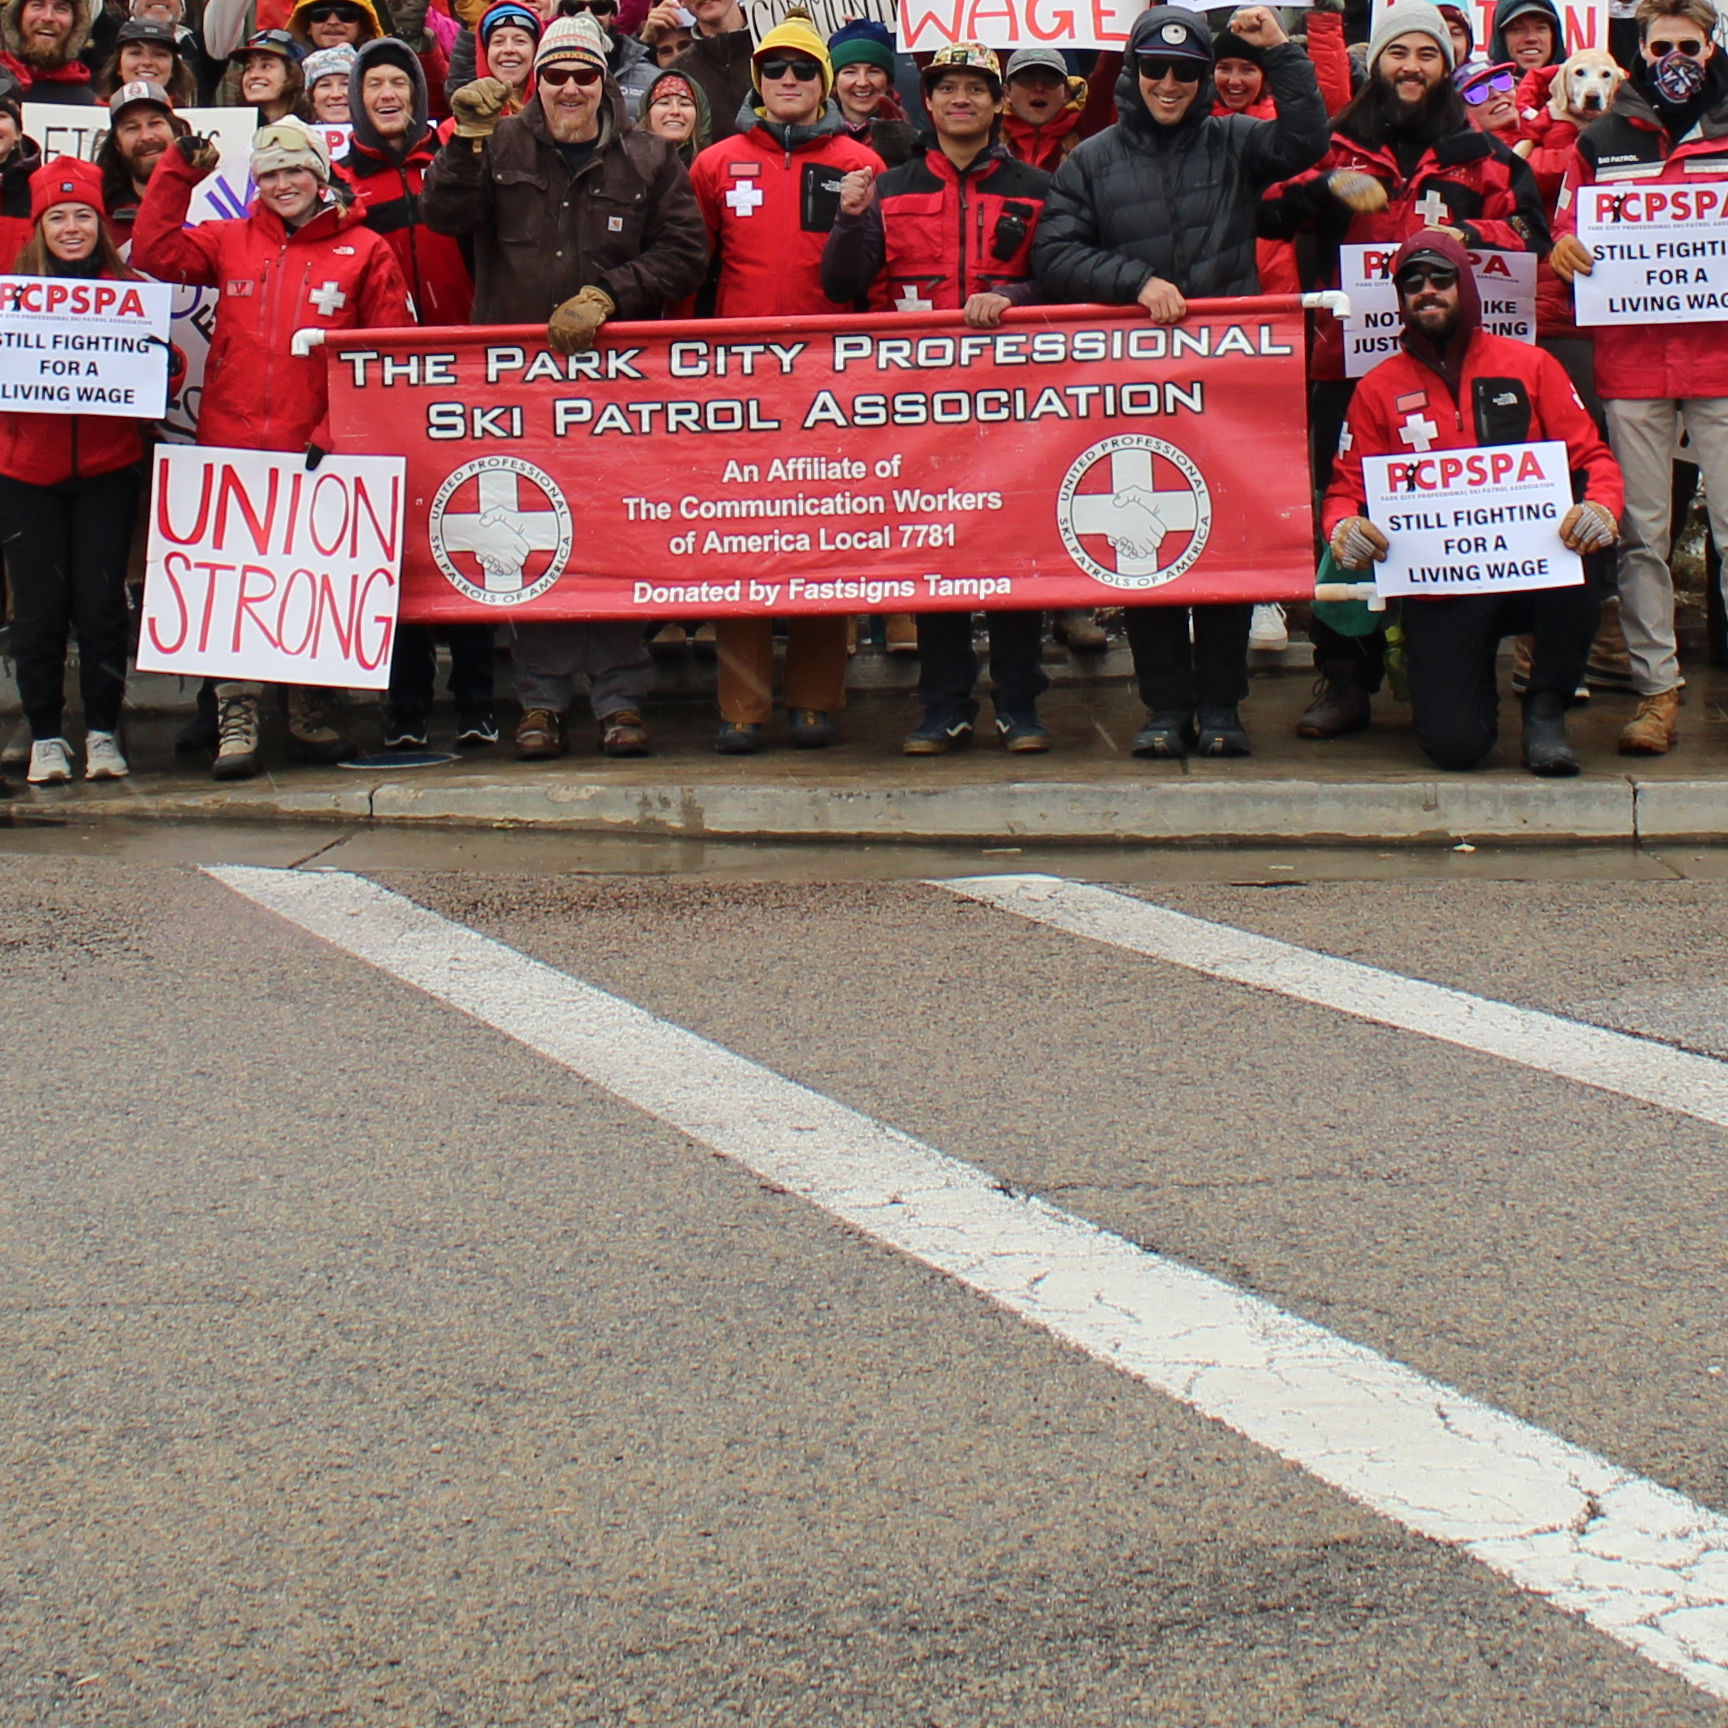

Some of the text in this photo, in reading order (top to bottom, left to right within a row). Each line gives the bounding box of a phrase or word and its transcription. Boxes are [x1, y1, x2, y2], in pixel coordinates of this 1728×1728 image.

[1593, 244, 1650, 261] STILL
[1646, 268, 1708, 285] FOR A
[1609, 295, 1680, 313] LIVING
[1365, 311, 1403, 328] NOT
[52, 335, 150, 353] FIGHTING
[340, 325, 1292, 386] THE PARK CITY PROFESSIONAL
[1354, 336, 1401, 354] JUST
[40, 360, 99, 376] FOR A
[1, 384, 135, 404] LIVING WAGE
[427, 381, 1204, 440] SKI PATROL ASSOCIATION
[722, 454, 902, 482] An Affiliate of
[1061, 437, 1205, 501] UNITED PROFESSIONAL
[1387, 451, 1546, 493] PCPSPA
[432, 458, 567, 520] UNITED PROFESSIONAL
[157, 458, 399, 562] UNION
[623, 488, 1003, 520] The Communication Workers
[1389, 502, 1556, 531] STILL FIGHTING
[670, 524, 956, 553] of America Local 7781
[1060, 515, 1209, 587] SKI PATROLS OF AMERICA
[1444, 535, 1508, 555] FOR A
[431, 535, 570, 603] SKI PATROLS OF AMERICA
[1408, 559, 1549, 583] LIVING WAGE
[633, 574, 1012, 606] Donated by Fastsigns Tampa
[148, 551, 395, 670] STRONG
